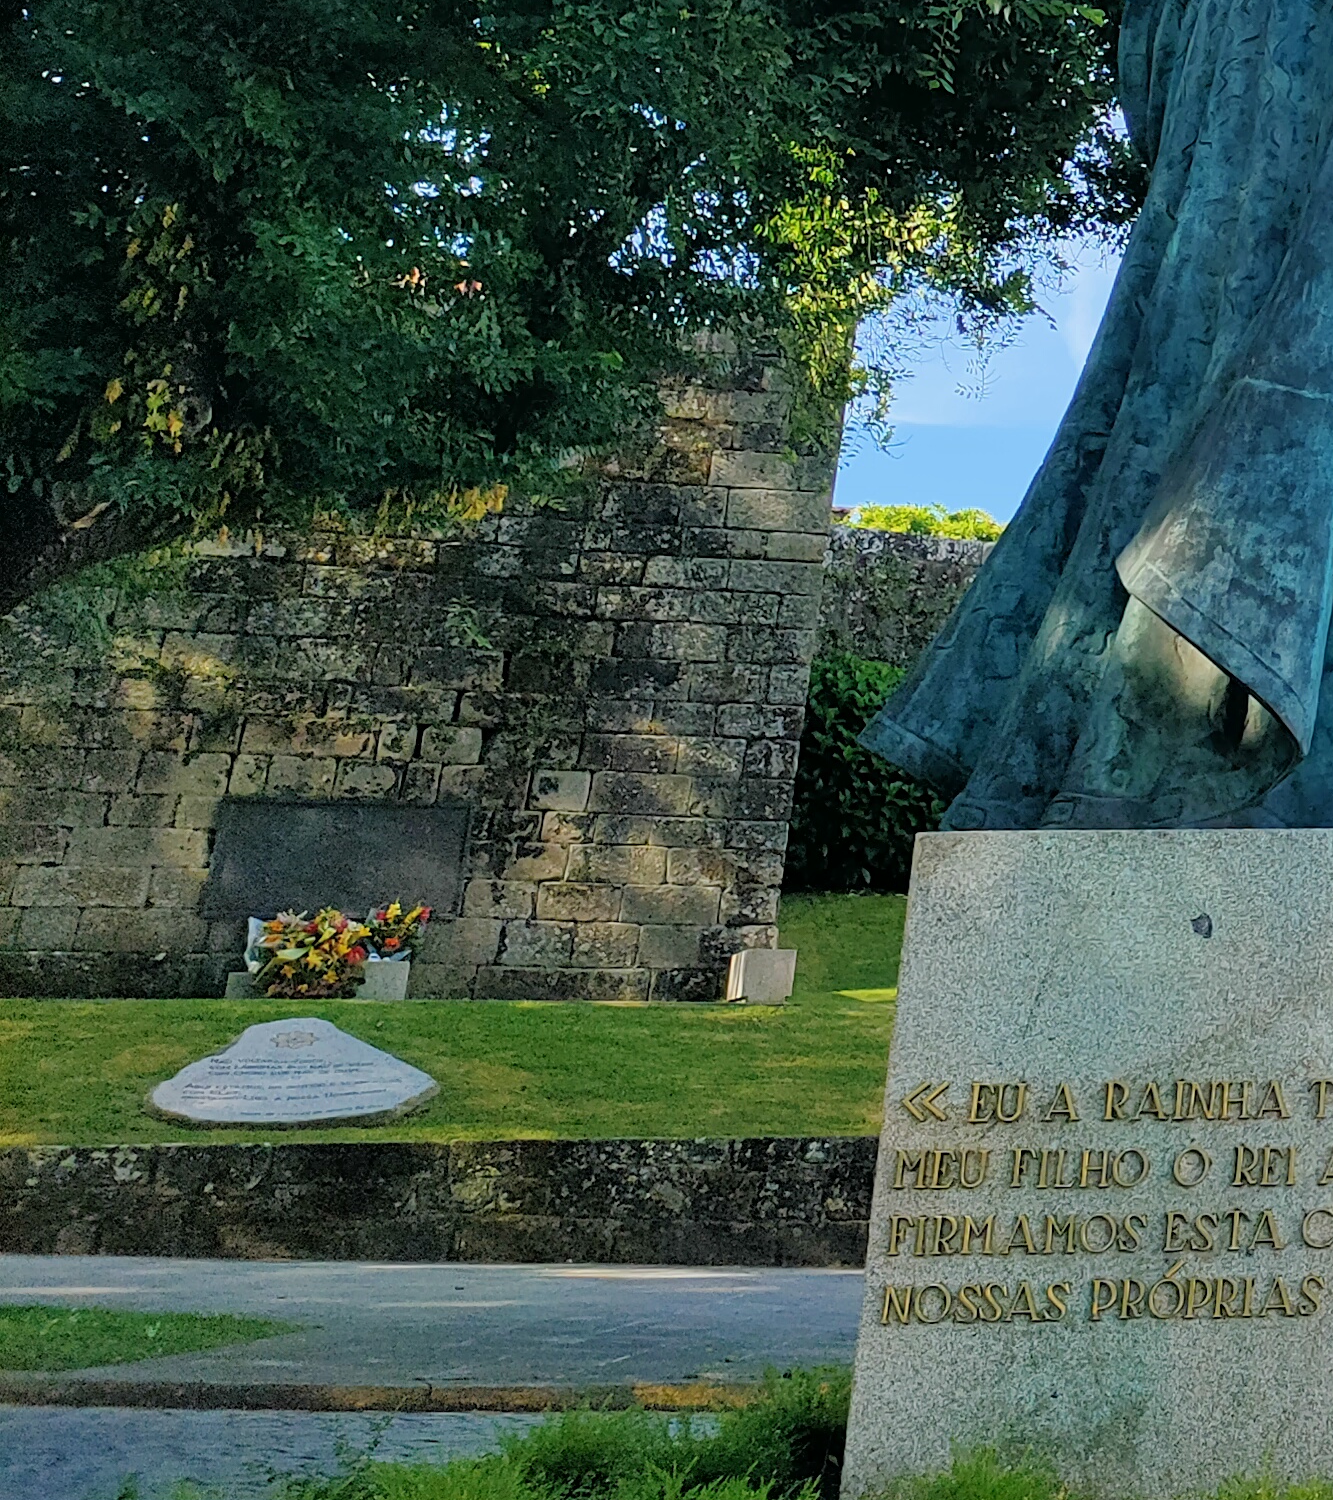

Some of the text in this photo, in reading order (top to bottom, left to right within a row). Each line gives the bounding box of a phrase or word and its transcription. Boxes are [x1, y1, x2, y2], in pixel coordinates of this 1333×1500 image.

[967, 1081, 1028, 1124] EU
[1043, 1081, 1080, 1122] A
[1104, 1077, 1292, 1122] RAINHA
[893, 1147, 992, 1190] MEU
[1009, 1146, 1150, 1190] FILHO
[1173, 1145, 1213, 1188] O
[1231, 1143, 1298, 1188] REI
[886, 1212, 1149, 1257] FIRMAMOS
[1163, 1208, 1286, 1252] ESTA
[880, 1280, 1072, 1326] NOSSAS
[1088, 1259, 1328, 1322] PRÓPRIAS
